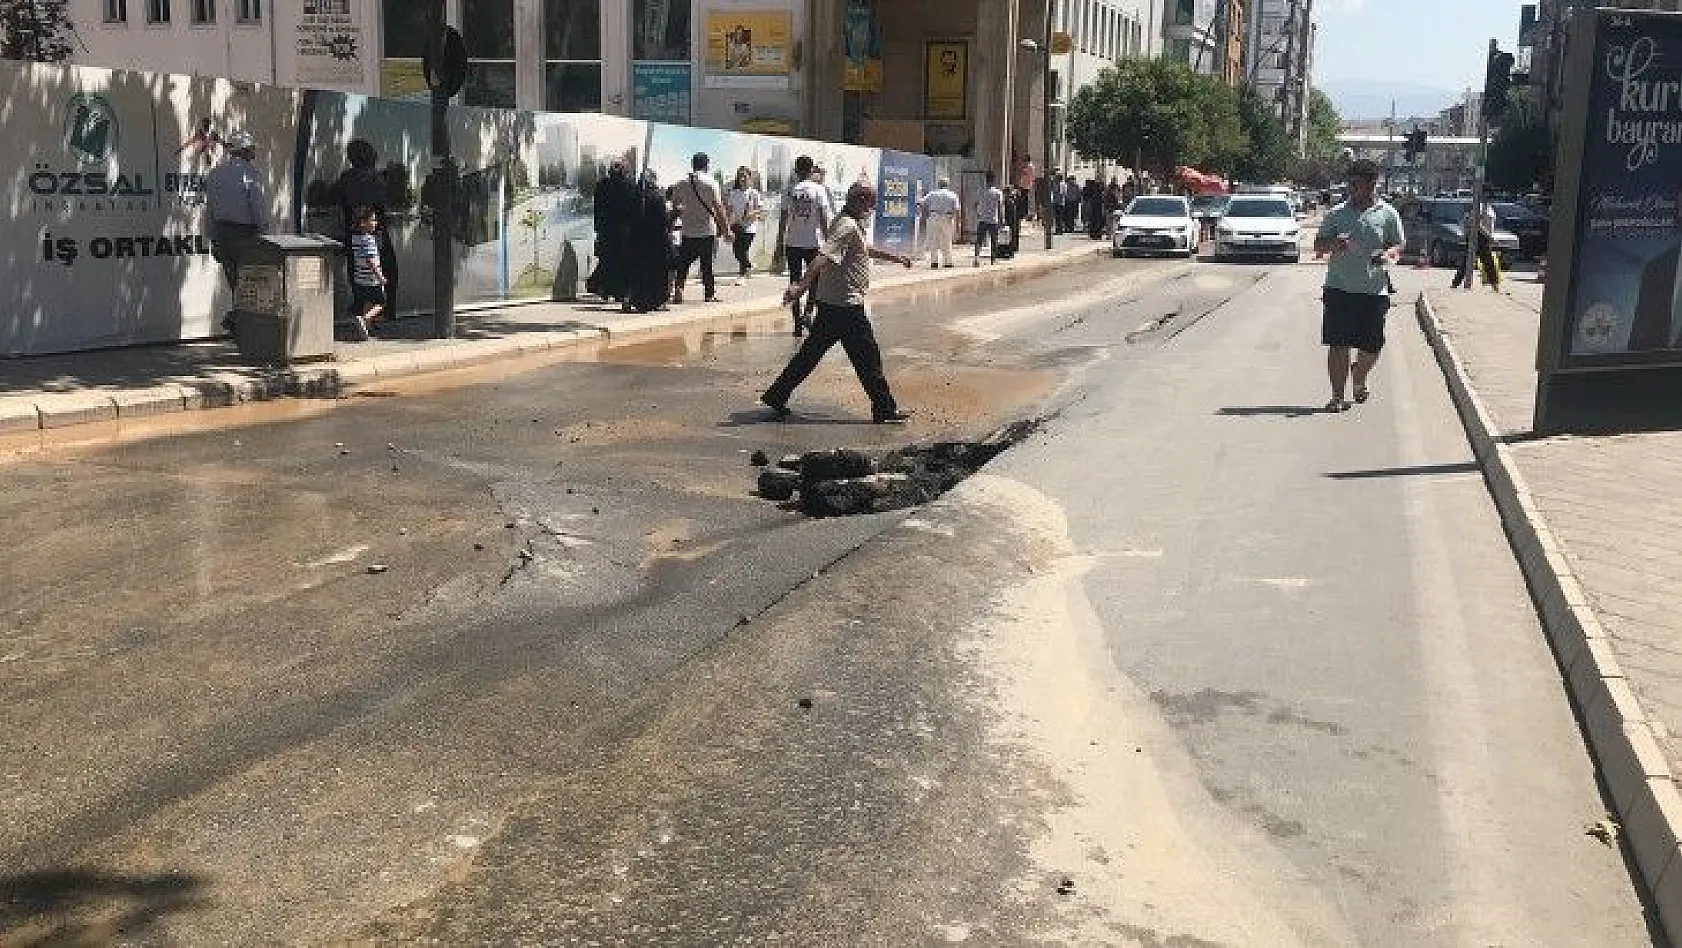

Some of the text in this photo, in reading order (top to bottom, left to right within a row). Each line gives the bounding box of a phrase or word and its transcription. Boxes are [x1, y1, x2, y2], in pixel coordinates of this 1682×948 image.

[1607, 37, 1682, 112] kur
[28, 162, 152, 196] ÖZSAL
[42, 232, 78, 265] İŞ
